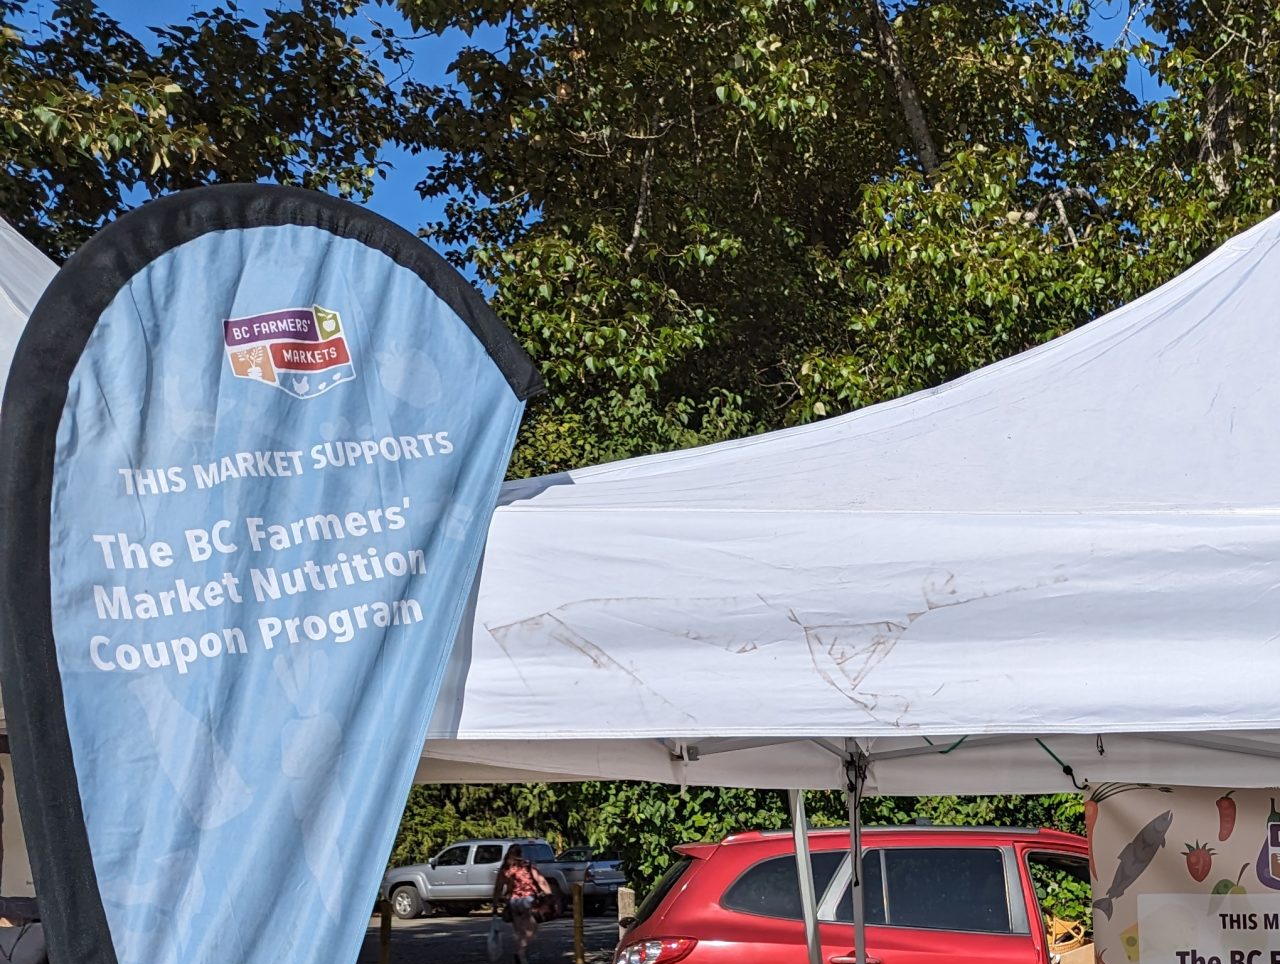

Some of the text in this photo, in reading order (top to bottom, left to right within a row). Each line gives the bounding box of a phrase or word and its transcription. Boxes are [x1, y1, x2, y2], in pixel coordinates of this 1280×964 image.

[233, 318, 311, 340] BC FARMERS'
[282, 346, 337, 364] MARKETS
[119, 431, 454, 496] THIS MARKET SUPPORTS
[94, 497, 411, 570] The BC Farmers'
[93, 546, 427, 621] Market Nutrition
[89, 597, 424, 674] Coupon Program
[1219, 913, 1258, 931] THIS
